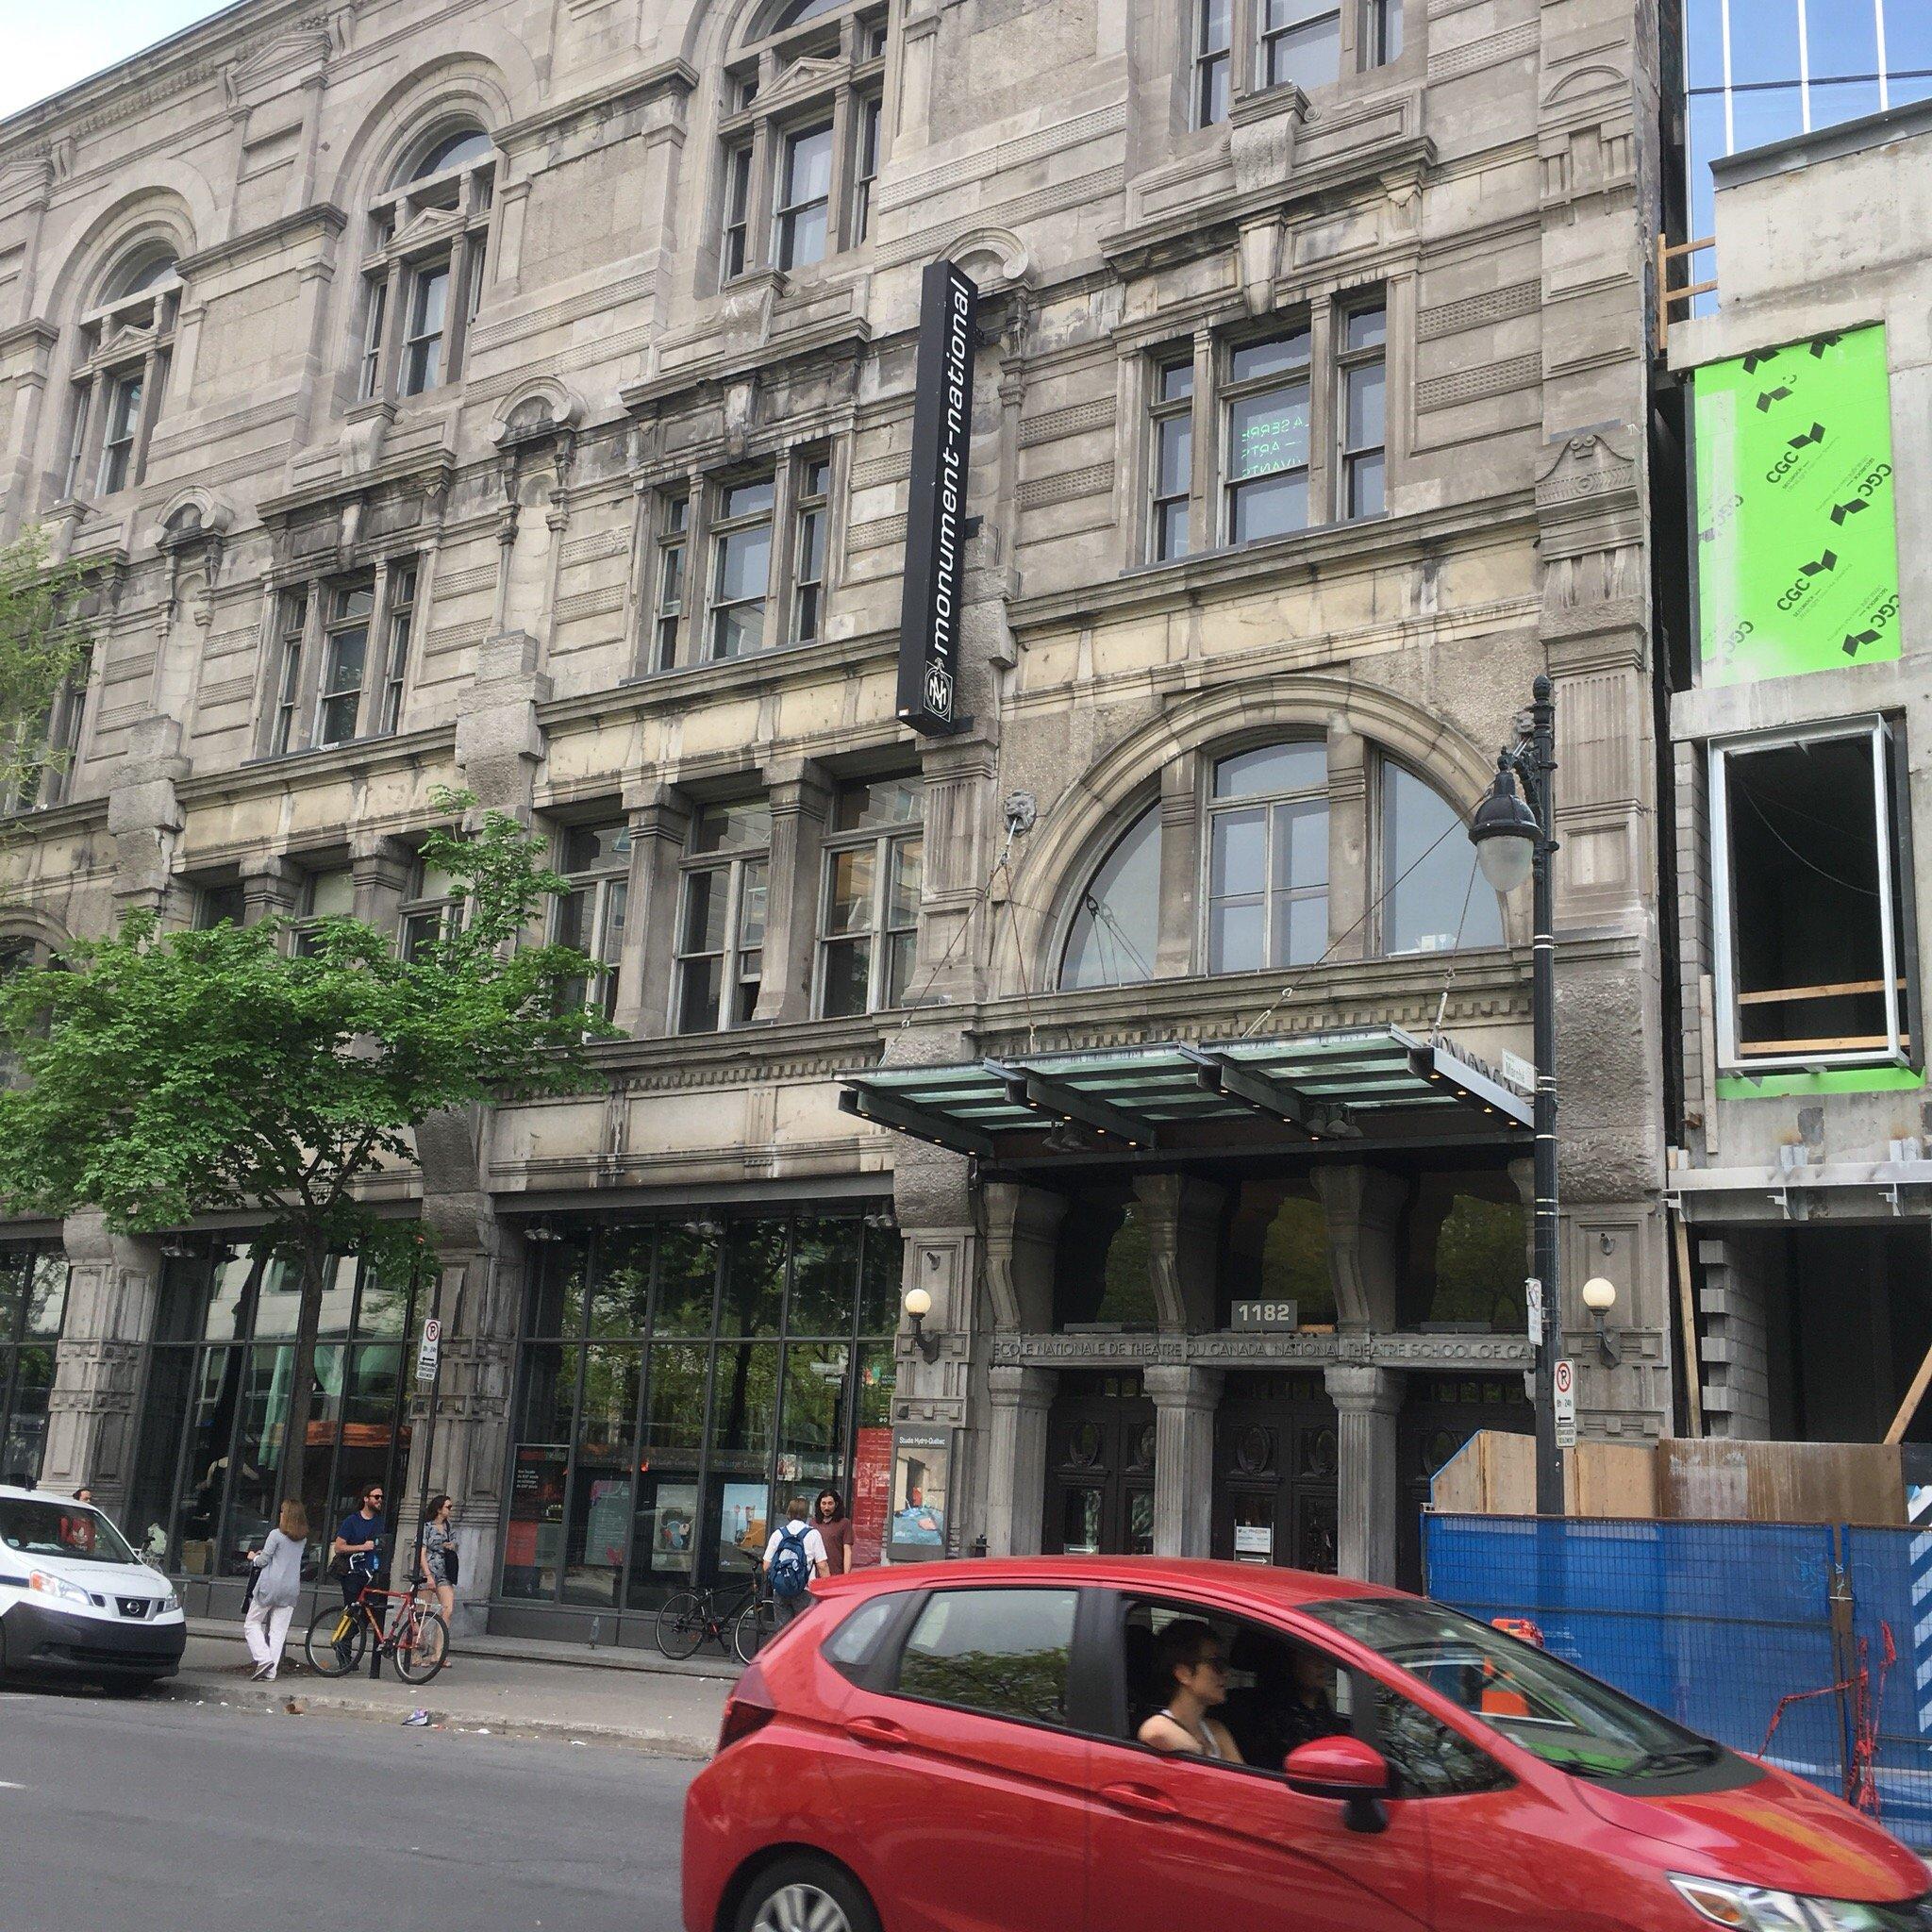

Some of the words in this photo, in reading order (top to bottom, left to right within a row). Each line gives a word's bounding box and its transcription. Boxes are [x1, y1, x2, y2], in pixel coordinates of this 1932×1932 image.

[934, 276, 970, 656] monument-national
[1766, 451, 1799, 483] CGC
[1857, 463, 1892, 496] CGC
[1777, 577, 1810, 611] CGC
[1239, 1304, 1290, 1321] 1182
[1038, 1342, 1106, 1357] NATIONALE
[1109, 1342, 1126, 1357] DE
[1187, 1342, 1206, 1357] DU
[1209, 1342, 1267, 1357] CANADA
[1479, 1344, 1502, 1358] OF
